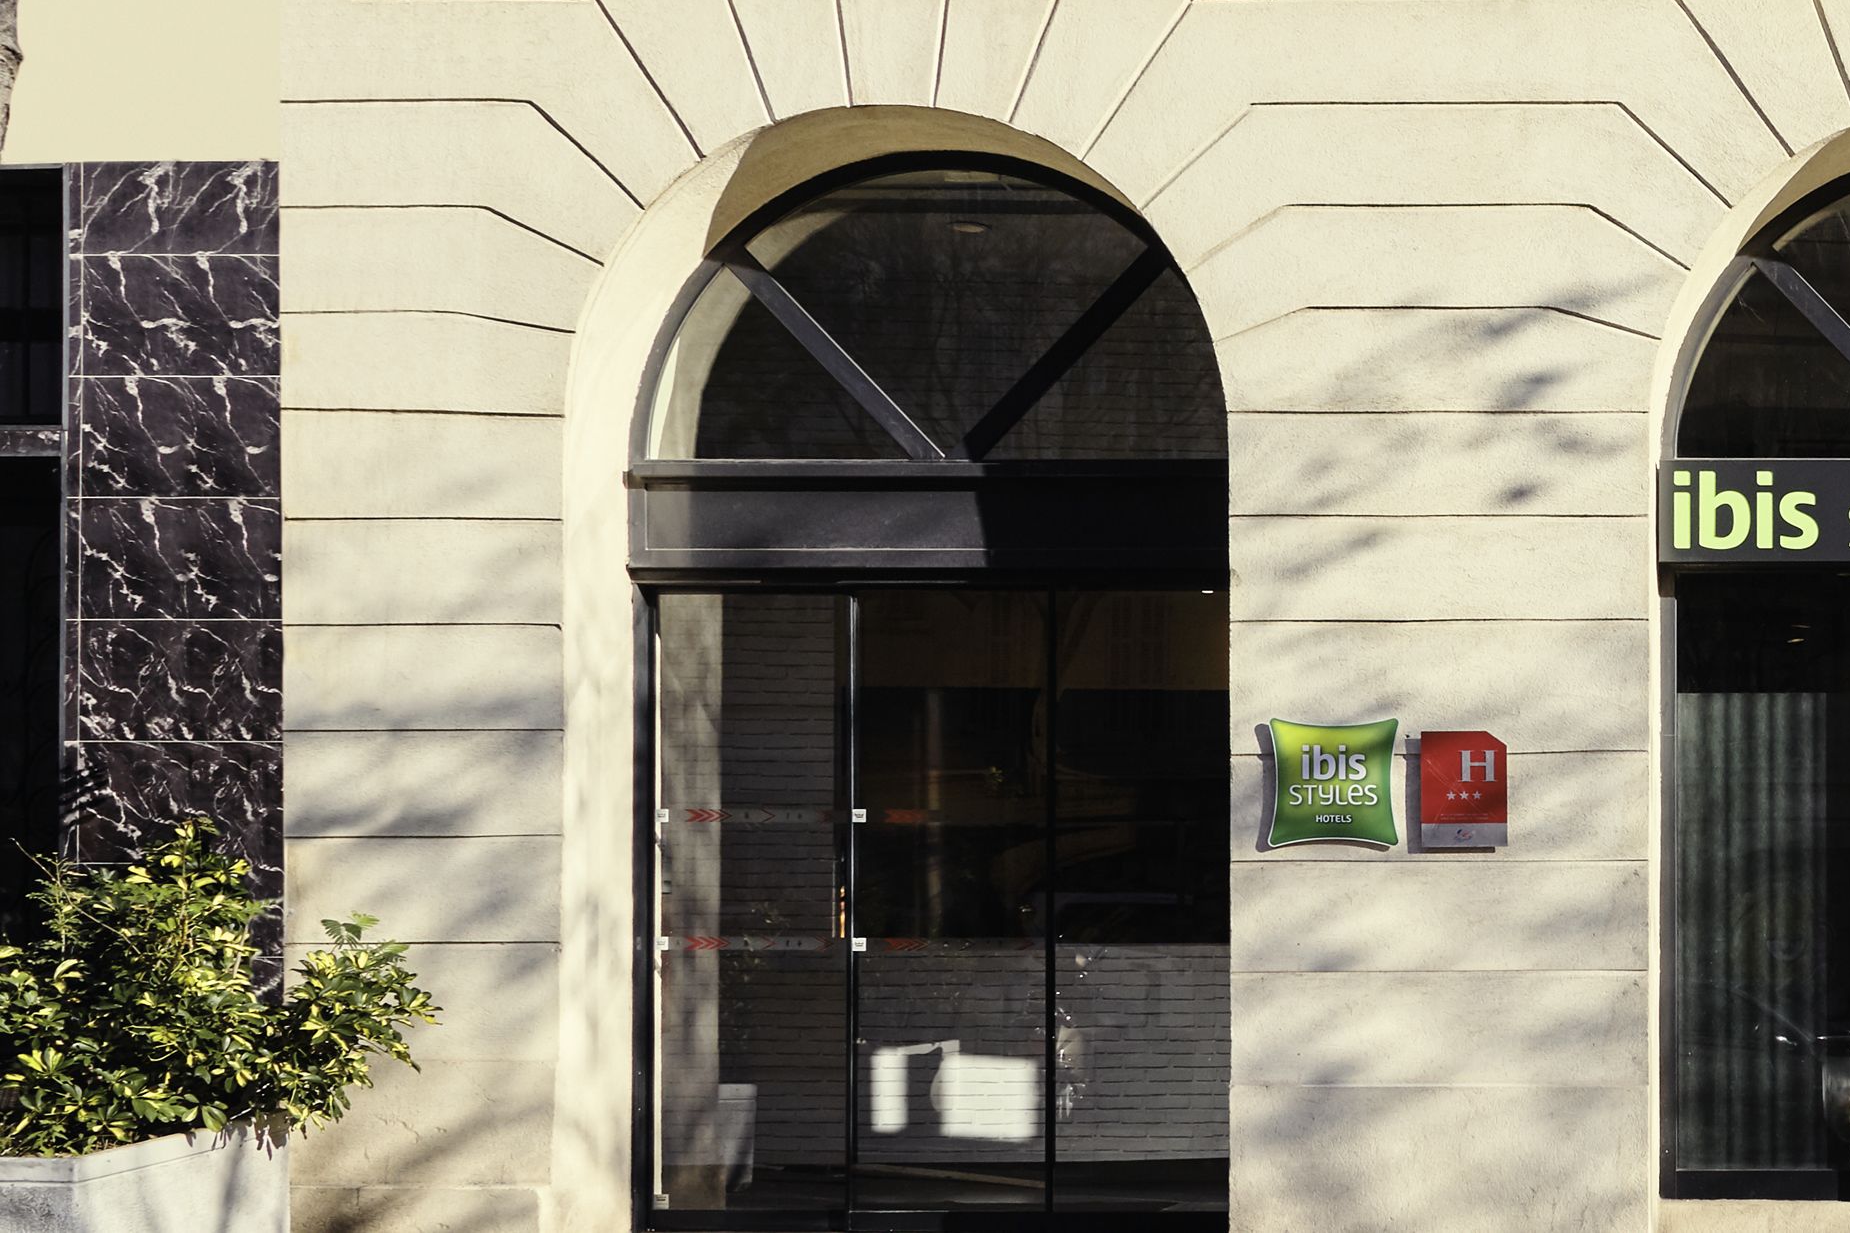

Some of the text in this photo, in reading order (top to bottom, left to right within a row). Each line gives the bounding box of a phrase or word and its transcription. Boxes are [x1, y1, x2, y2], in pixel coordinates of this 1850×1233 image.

[1673, 470, 1819, 550] ibis
[1301, 744, 1367, 780] ibis
[1459, 749, 1497, 782] H
[1315, 814, 1352, 823] HOTELS
